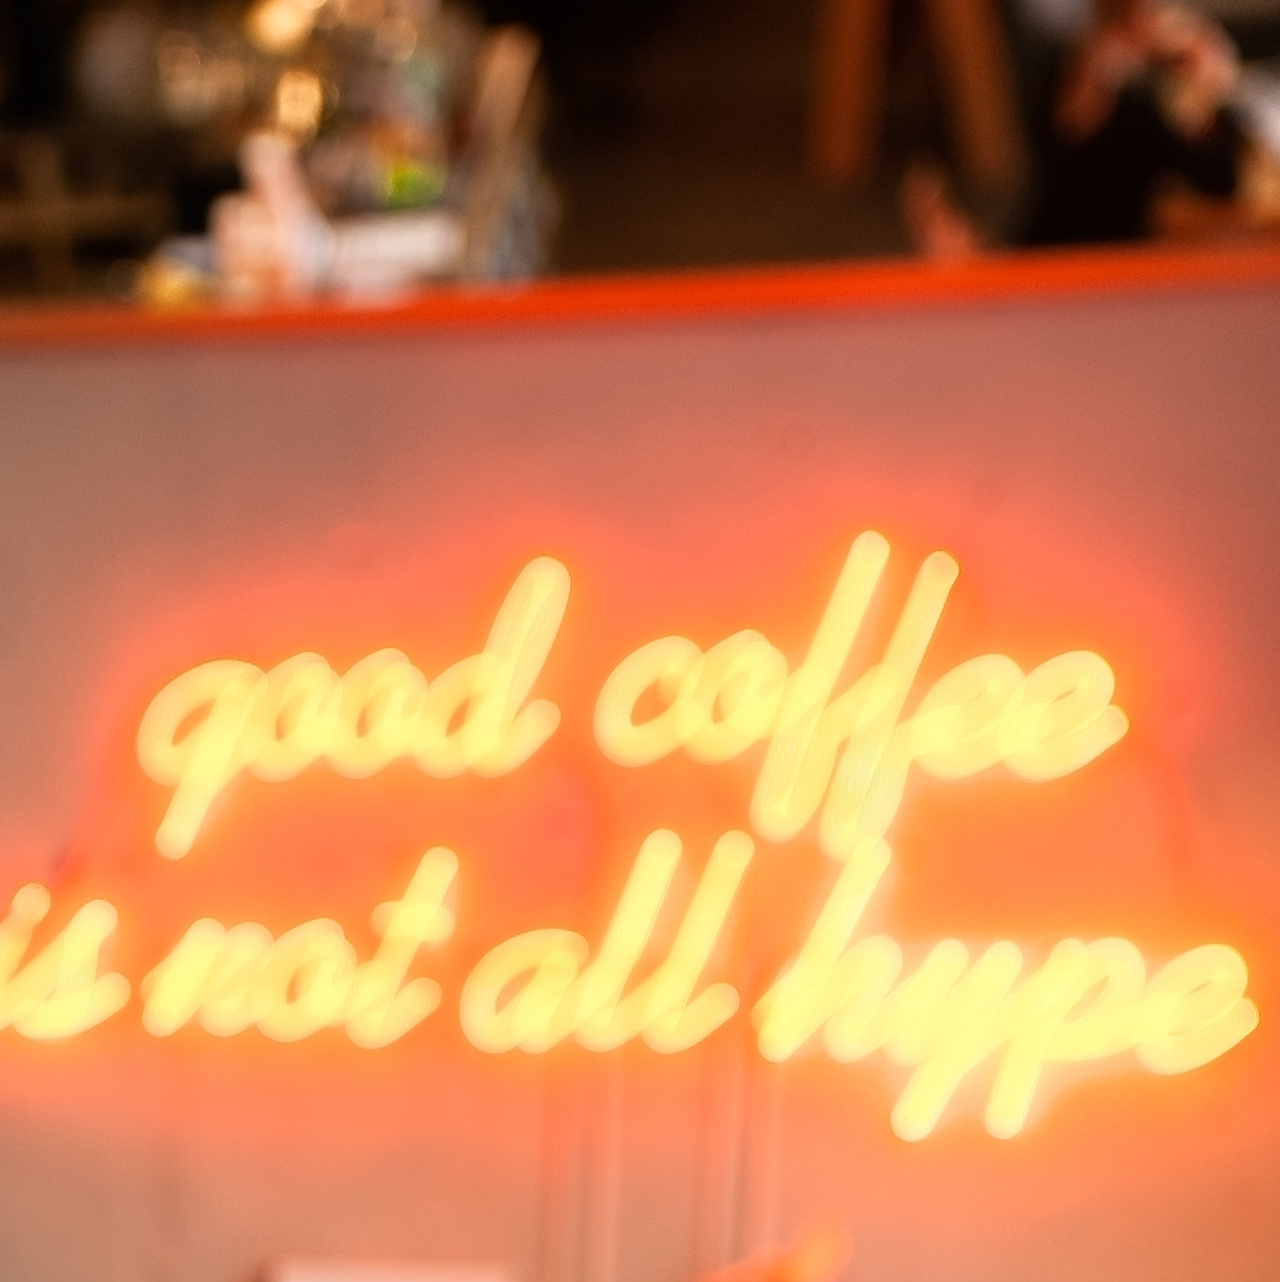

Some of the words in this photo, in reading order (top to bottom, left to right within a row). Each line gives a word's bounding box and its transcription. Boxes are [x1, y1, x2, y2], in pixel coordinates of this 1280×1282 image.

[136, 554, 570, 859] good
[594, 530, 1129, 860] coffee
[143, 847, 455, 1049] not
[460, 828, 755, 1054] all
[756, 836, 1260, 1142] hype
